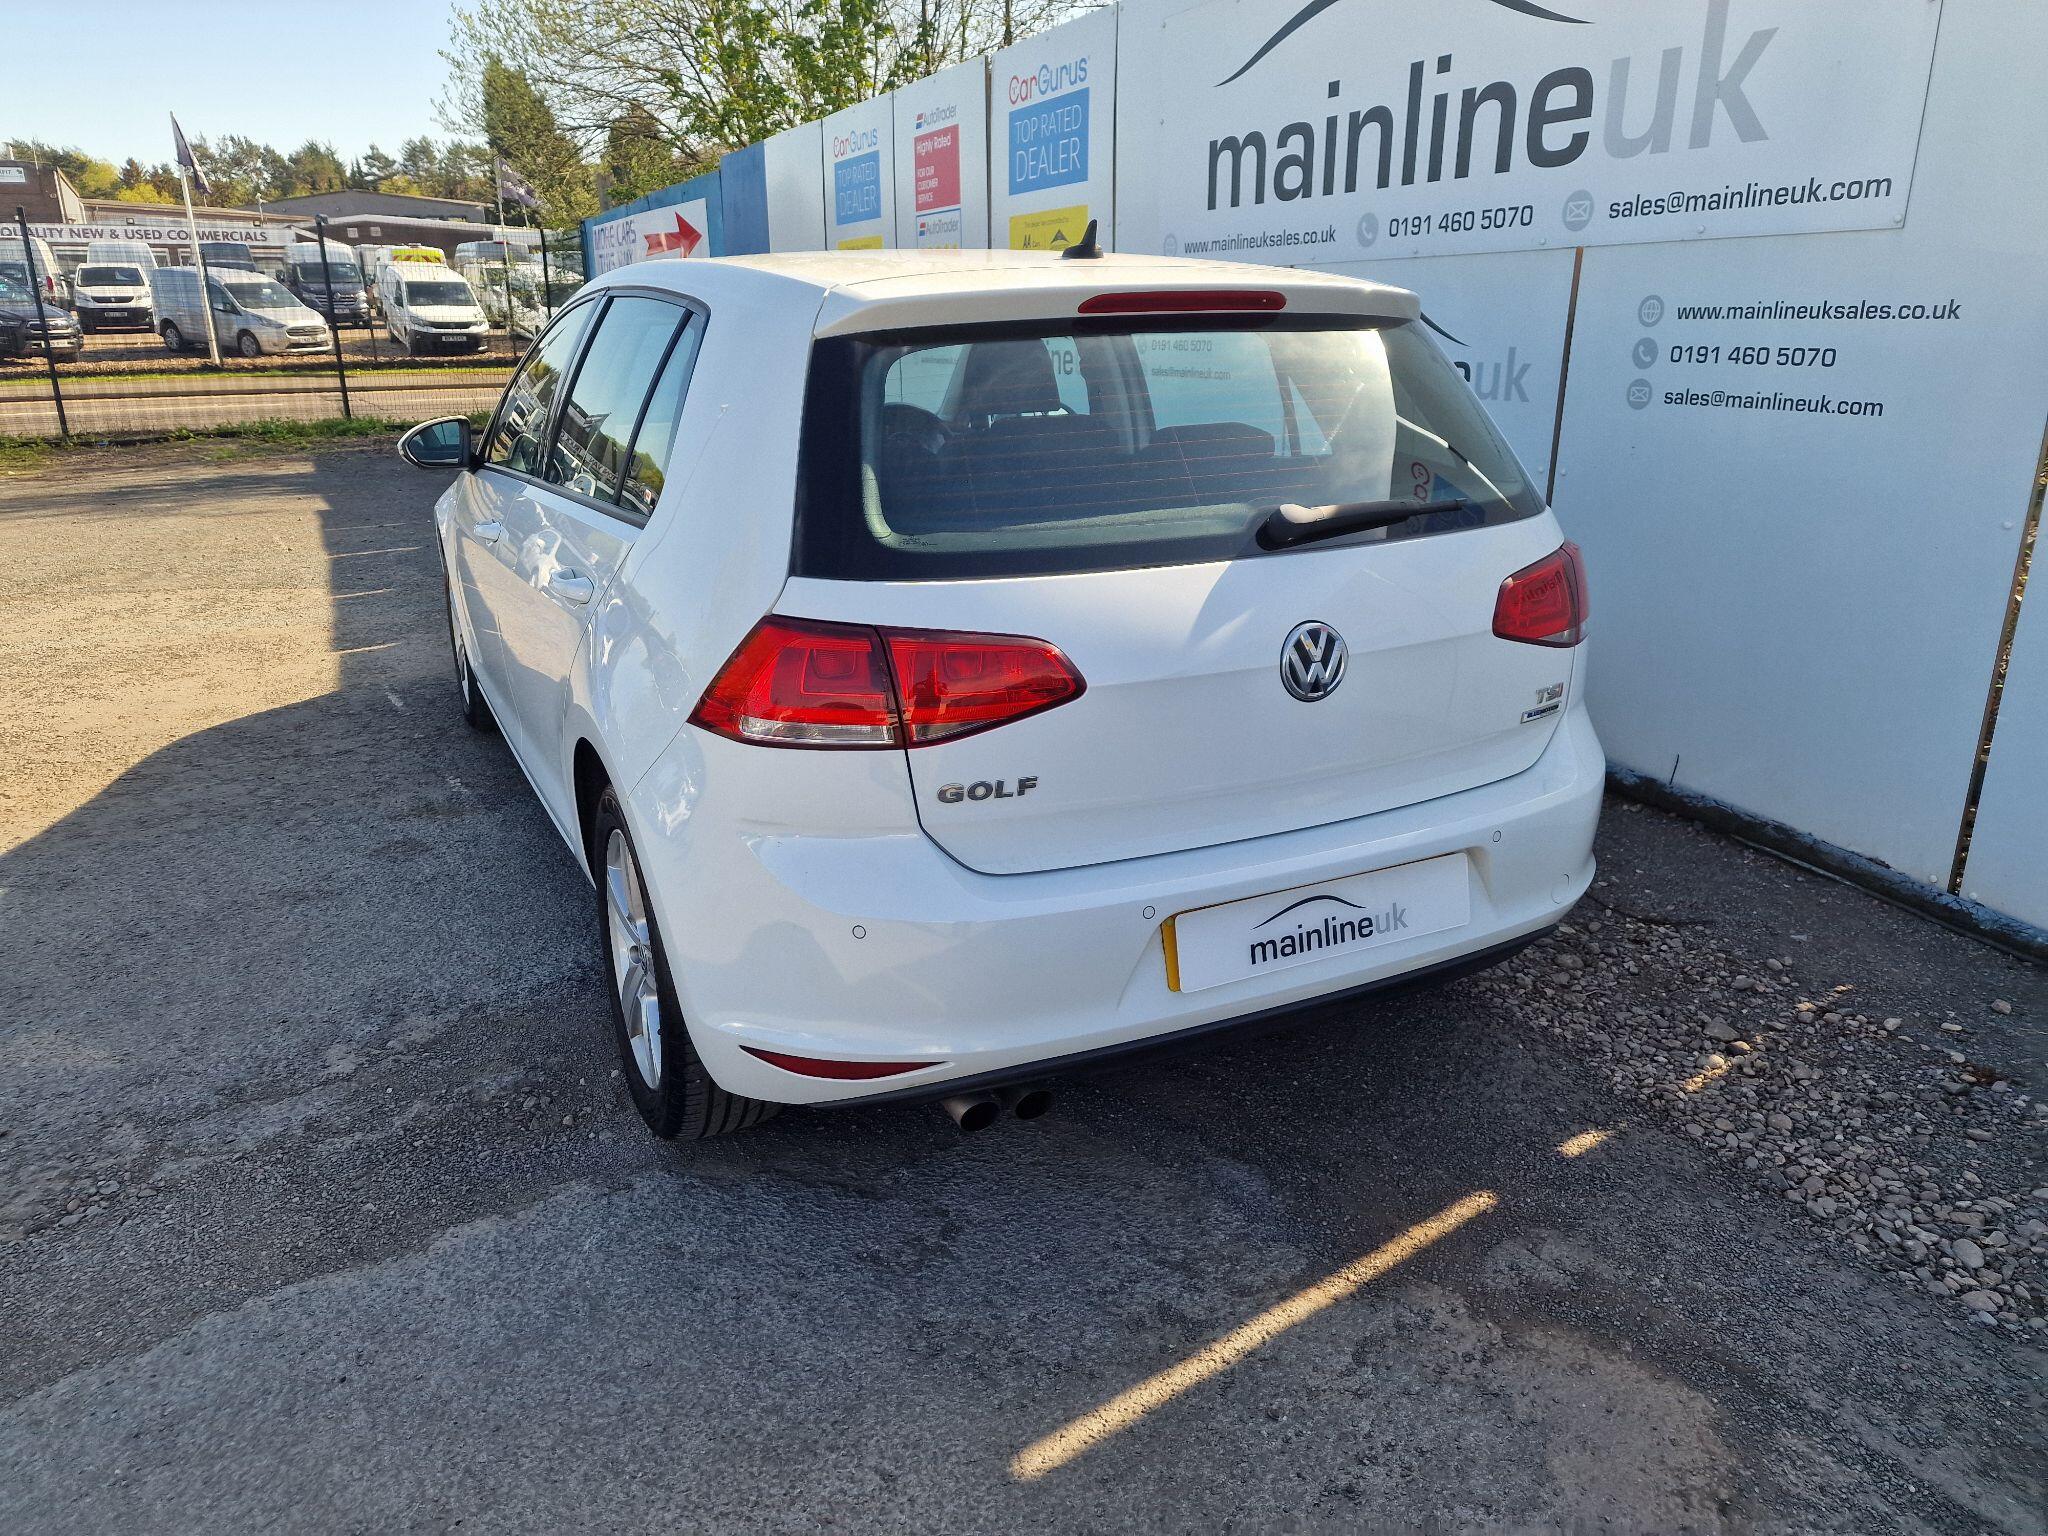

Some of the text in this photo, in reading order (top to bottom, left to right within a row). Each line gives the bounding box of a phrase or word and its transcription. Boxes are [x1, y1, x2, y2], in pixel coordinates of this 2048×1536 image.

[1009, 57, 1088, 105] CarGurus
[922, 104, 958, 127] AutoTrader
[1015, 104, 1082, 144] TOP RATED
[833, 128, 878, 158] CarGurus
[1016, 137, 1081, 182] DEALER
[838, 161, 876, 187] TOP RATED
[840, 185, 877, 216] DEALER
[1608, 177, 1892, 219] sales@mainlineuk.com
[69, 228, 104, 239] NEW
[110, 229, 120, 239] &
[124, 229, 162, 240] USED
[1389, 205, 1533, 237] 0191 460 5070
[1184, 225, 1336, 253] www.mainlineuksales.co.uk
[1677, 299, 1962, 321] www.mainlineuksales.co.uk
[1670, 345, 1837, 367] 0191 460 5070
[1664, 389, 1884, 417] sales@mainlineuk.com
[1536, 682, 1564, 704] TSI
[937, 776, 1038, 803] GOLF
[1250, 902, 1408, 965] mainlineuk
